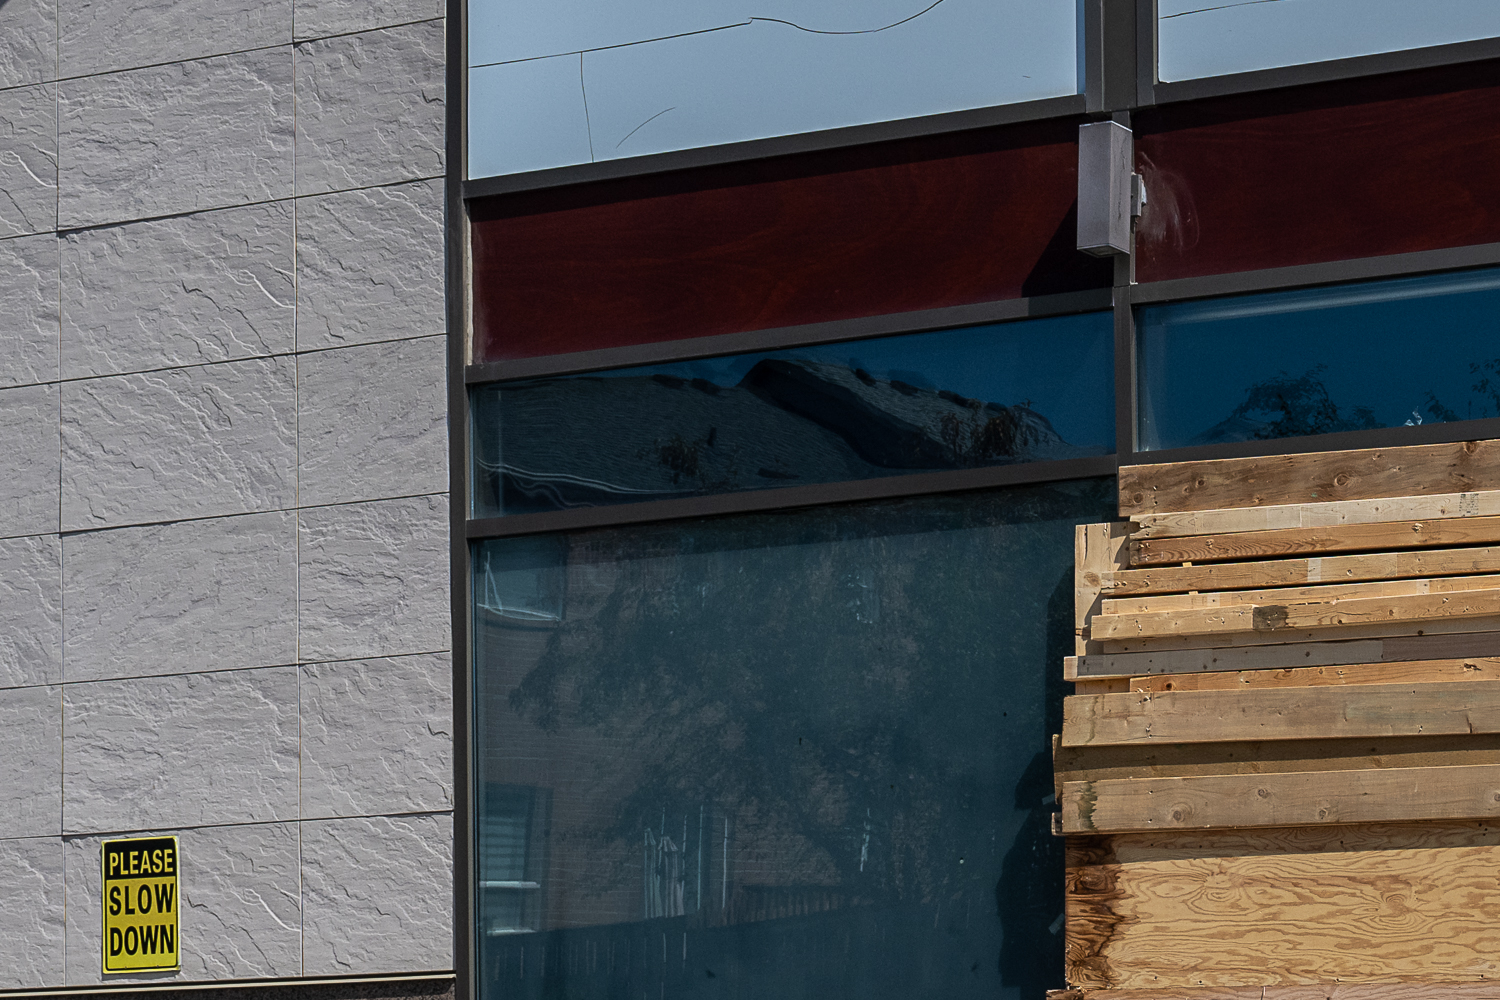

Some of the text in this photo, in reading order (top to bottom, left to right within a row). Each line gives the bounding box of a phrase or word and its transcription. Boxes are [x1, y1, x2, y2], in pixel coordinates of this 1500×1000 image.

[109, 849, 174, 876] PLEASE
[109, 883, 175, 916] SLOW
[109, 924, 175, 957] DOWN
